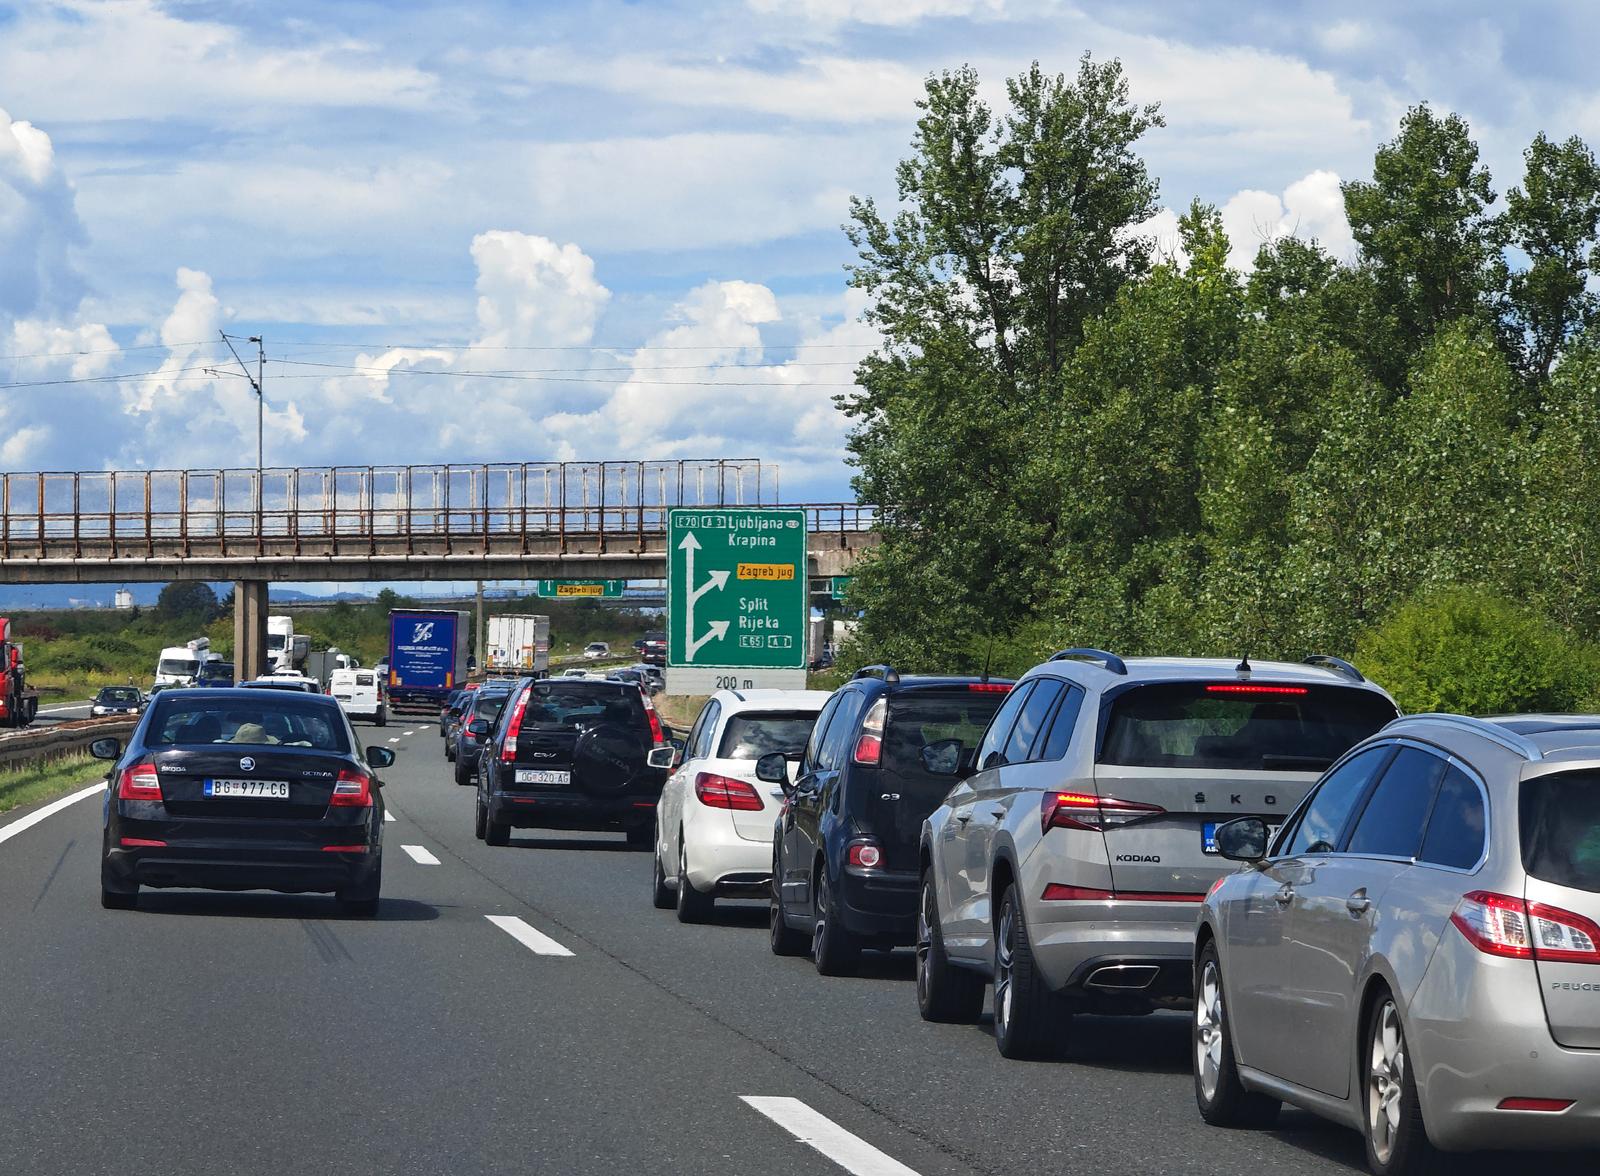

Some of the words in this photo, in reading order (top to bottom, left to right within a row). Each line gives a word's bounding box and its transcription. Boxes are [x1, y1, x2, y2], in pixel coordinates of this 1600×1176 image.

[728, 515, 783, 532] Ljubljana
[728, 533, 776, 549] Krapina
[739, 565, 774, 578] Zagreb
[777, 566, 793, 579] jug
[558, 585, 587, 595] Zagreb
[739, 597, 768, 613] Split
[739, 615, 779, 632] Rijeka
[716, 676, 737, 689] 200
[743, 679, 753, 689] m
[214, 781, 231, 794] BG
[1195, 792, 1277, 805] ŠKO
[1116, 854, 1161, 864] KODIAQ
[1551, 982, 1600, 991] PEUGE
